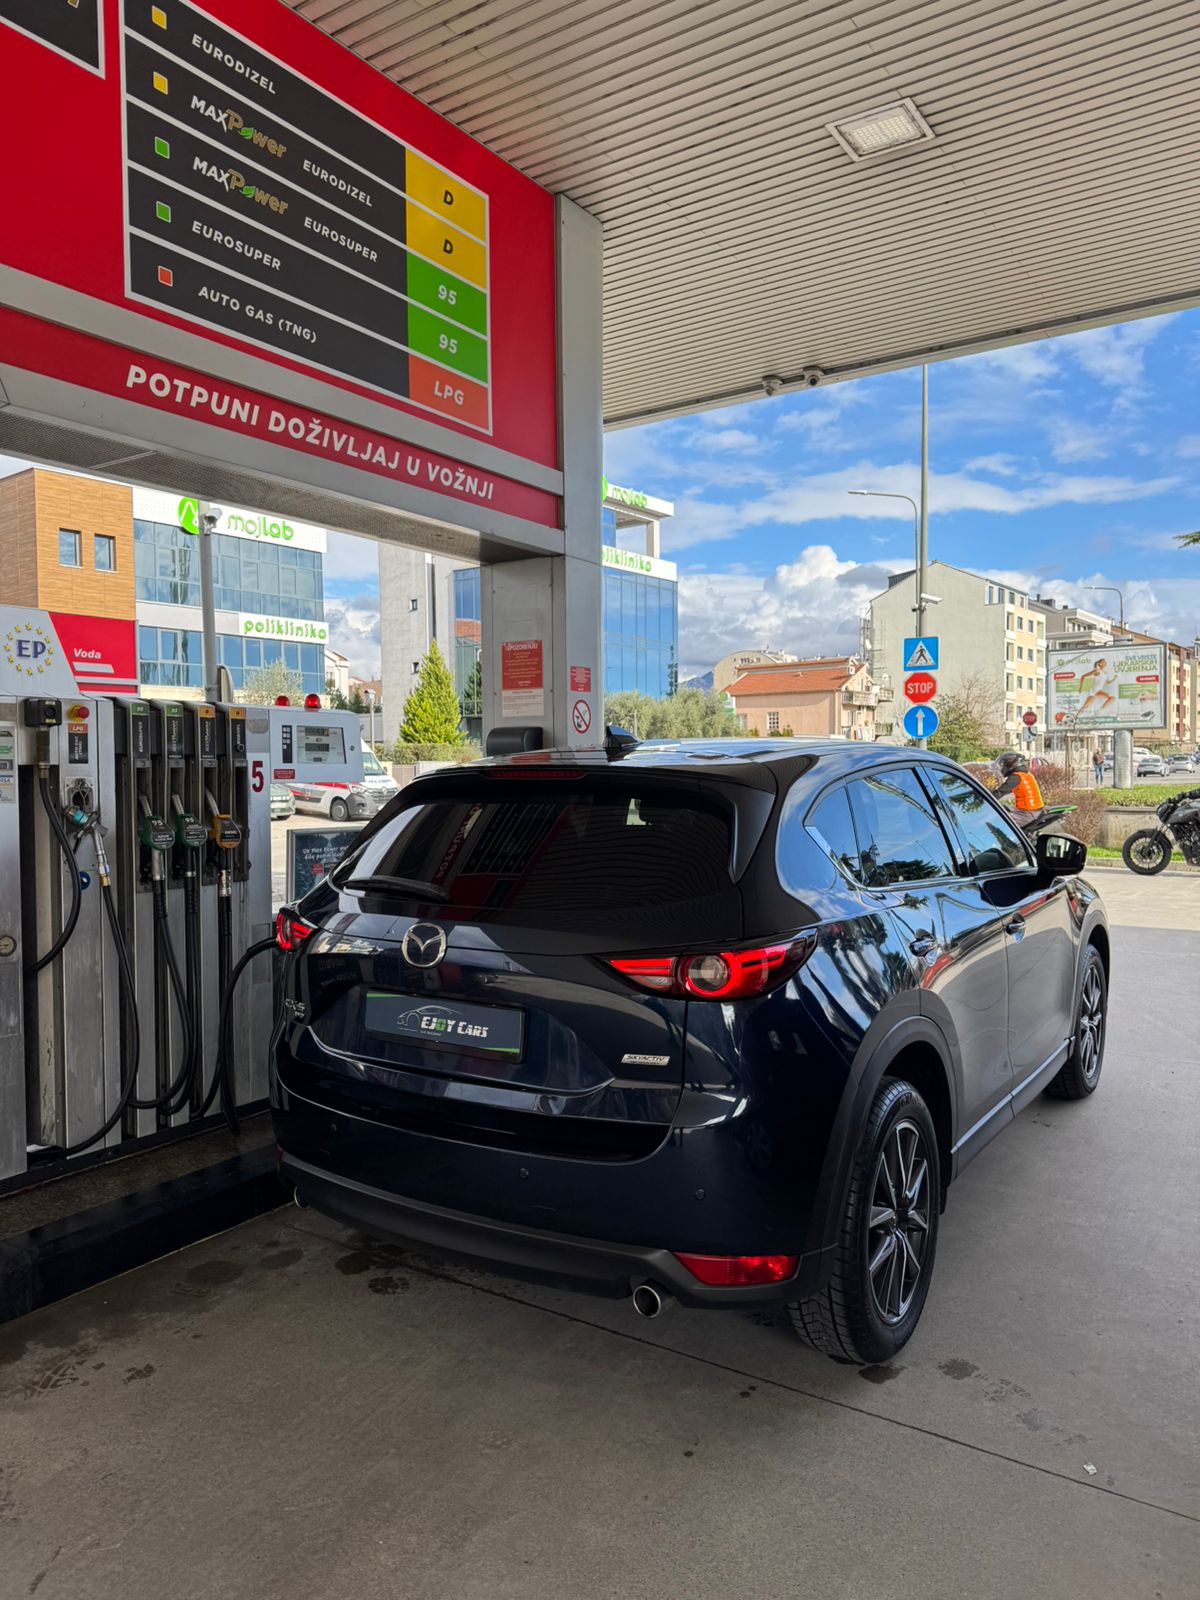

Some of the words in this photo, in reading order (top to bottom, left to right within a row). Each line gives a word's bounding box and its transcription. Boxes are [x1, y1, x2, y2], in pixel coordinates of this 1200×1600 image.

[192, 33, 276, 95] EURODIZEL
[302, 158, 374, 208] EURODIZEL
[443, 189, 454, 206] D
[192, 221, 282, 272] EUROSUPER
[304, 216, 378, 263] EUROSUPER
[443, 238, 454, 256] D
[437, 284, 457, 307] 95
[198, 285, 240, 312] AUTO
[245, 302, 274, 326] GAS
[278, 318, 317, 344] (TNG)
[438, 333, 458, 355] 95
[433, 380, 465, 406] LPG
[126, 364, 260, 427] POTPUNI
[268, 408, 400, 471] DOŽIVLJAJ
[406, 456, 420, 477] U
[427, 459, 495, 500] VOŽNJI
[228, 514, 295, 541] mojlab
[244, 618, 327, 640] poliklinika
[16, 639, 47, 659] EP
[73, 648, 102, 660] Voda
[907, 682, 934, 694] STOP
[251, 761, 265, 793] 5
